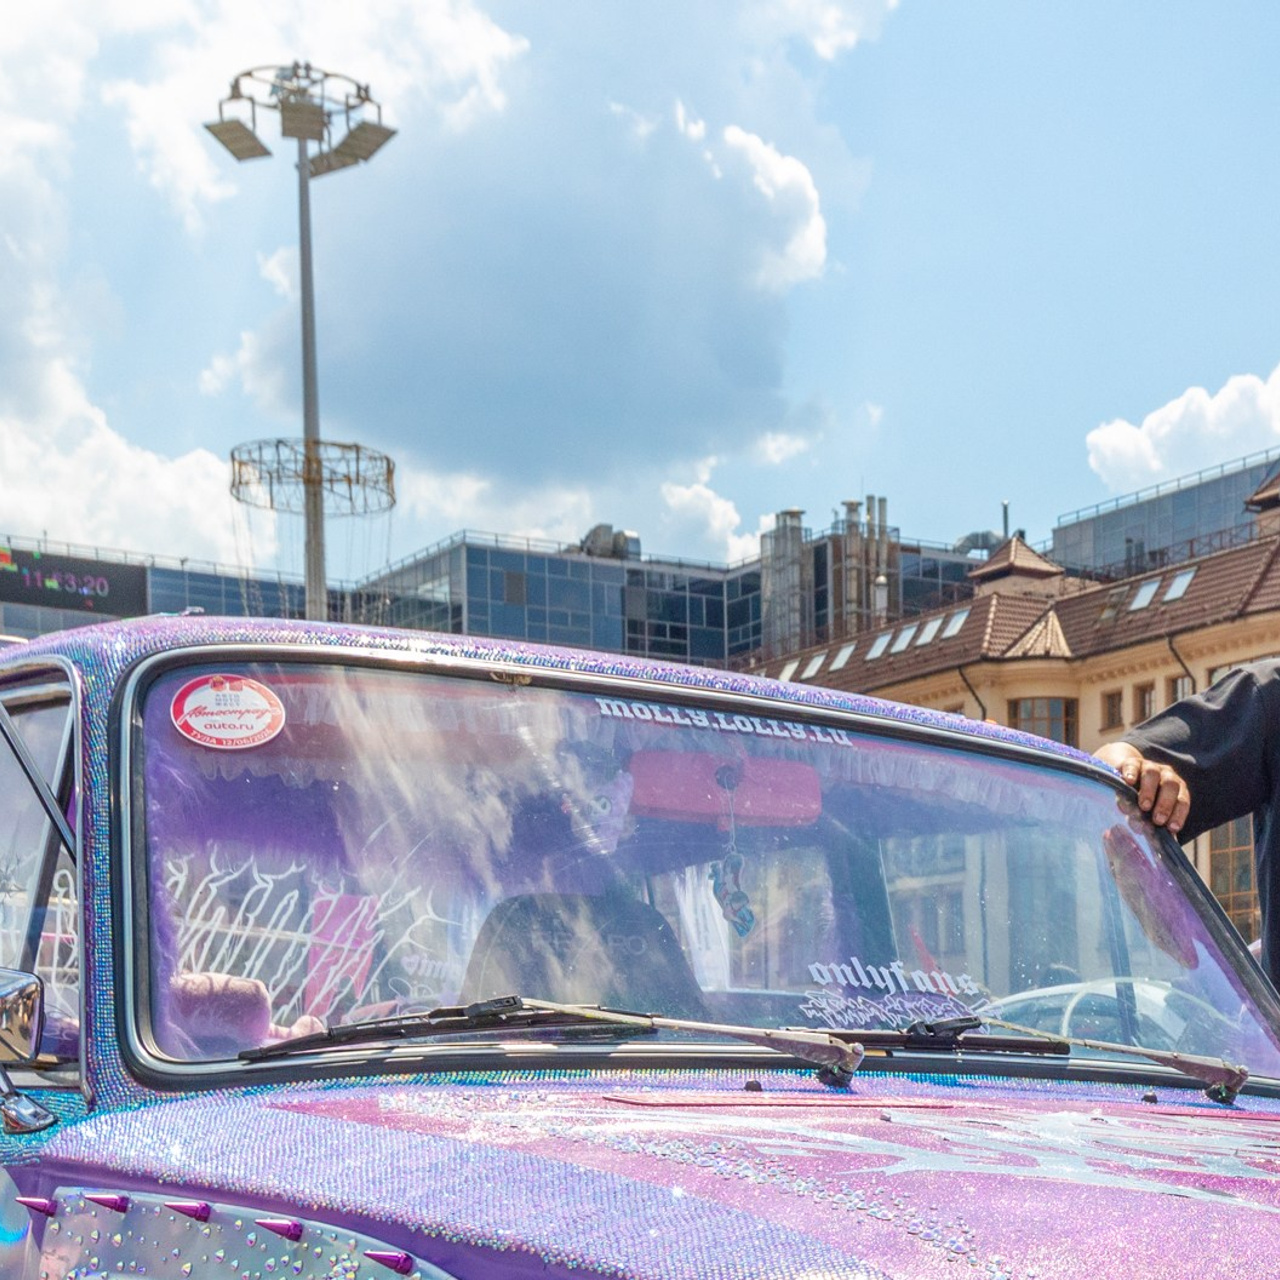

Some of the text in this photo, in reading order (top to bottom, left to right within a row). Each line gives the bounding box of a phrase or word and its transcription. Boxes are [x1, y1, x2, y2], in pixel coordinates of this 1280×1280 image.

[203, 722, 254, 731] auto.ru
[190, 729, 218, 746] ТУЛА
[808, 956, 981, 996] onlyfans
